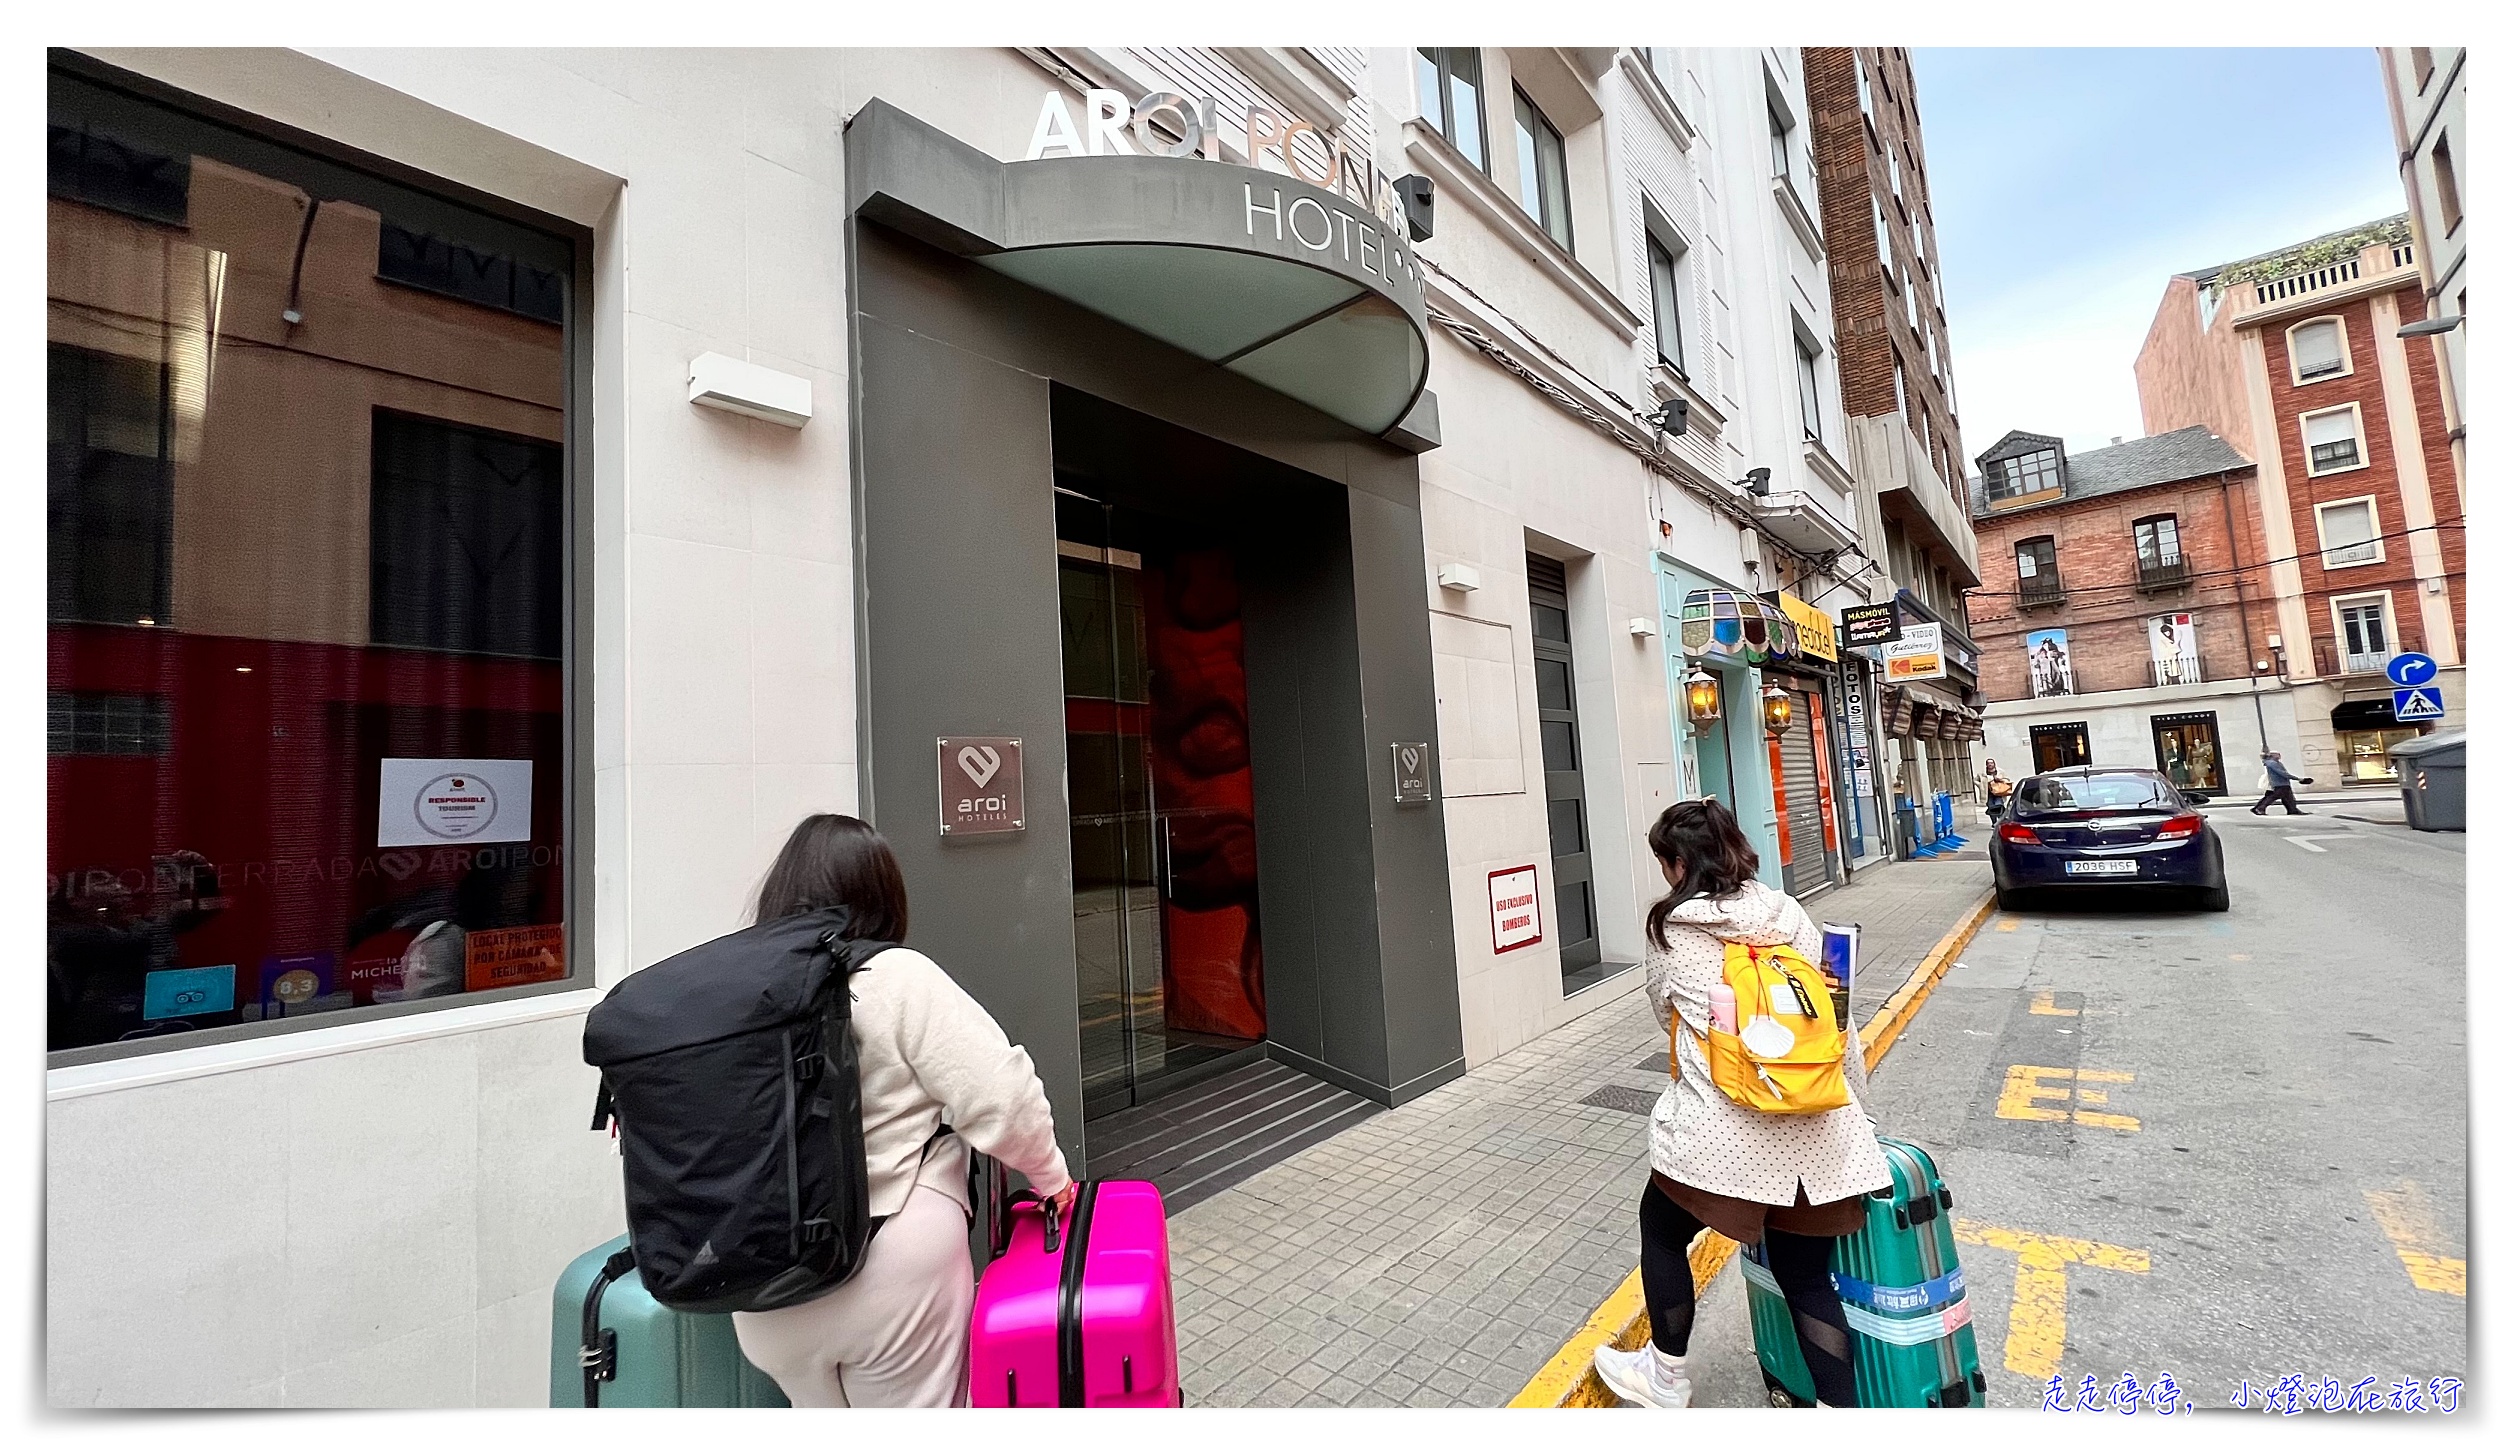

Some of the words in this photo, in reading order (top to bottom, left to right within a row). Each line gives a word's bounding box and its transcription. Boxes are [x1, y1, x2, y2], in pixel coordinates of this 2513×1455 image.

[1025, 88, 1220, 161] AROI
[1244, 182, 1394, 287] HOTEL
[1912, 665, 1937, 673] Kodak
[1846, 662, 1861, 714] FOTOS
[1402, 777, 1423, 789] aroi
[428, 796, 486, 804] RESPONSIBLE
[957, 794, 1007, 813] aroi
[958, 812, 1008, 822] HOTELES
[2075, 861, 2106, 872] 2036
[508, 927, 563, 944] PROTEGIDO
